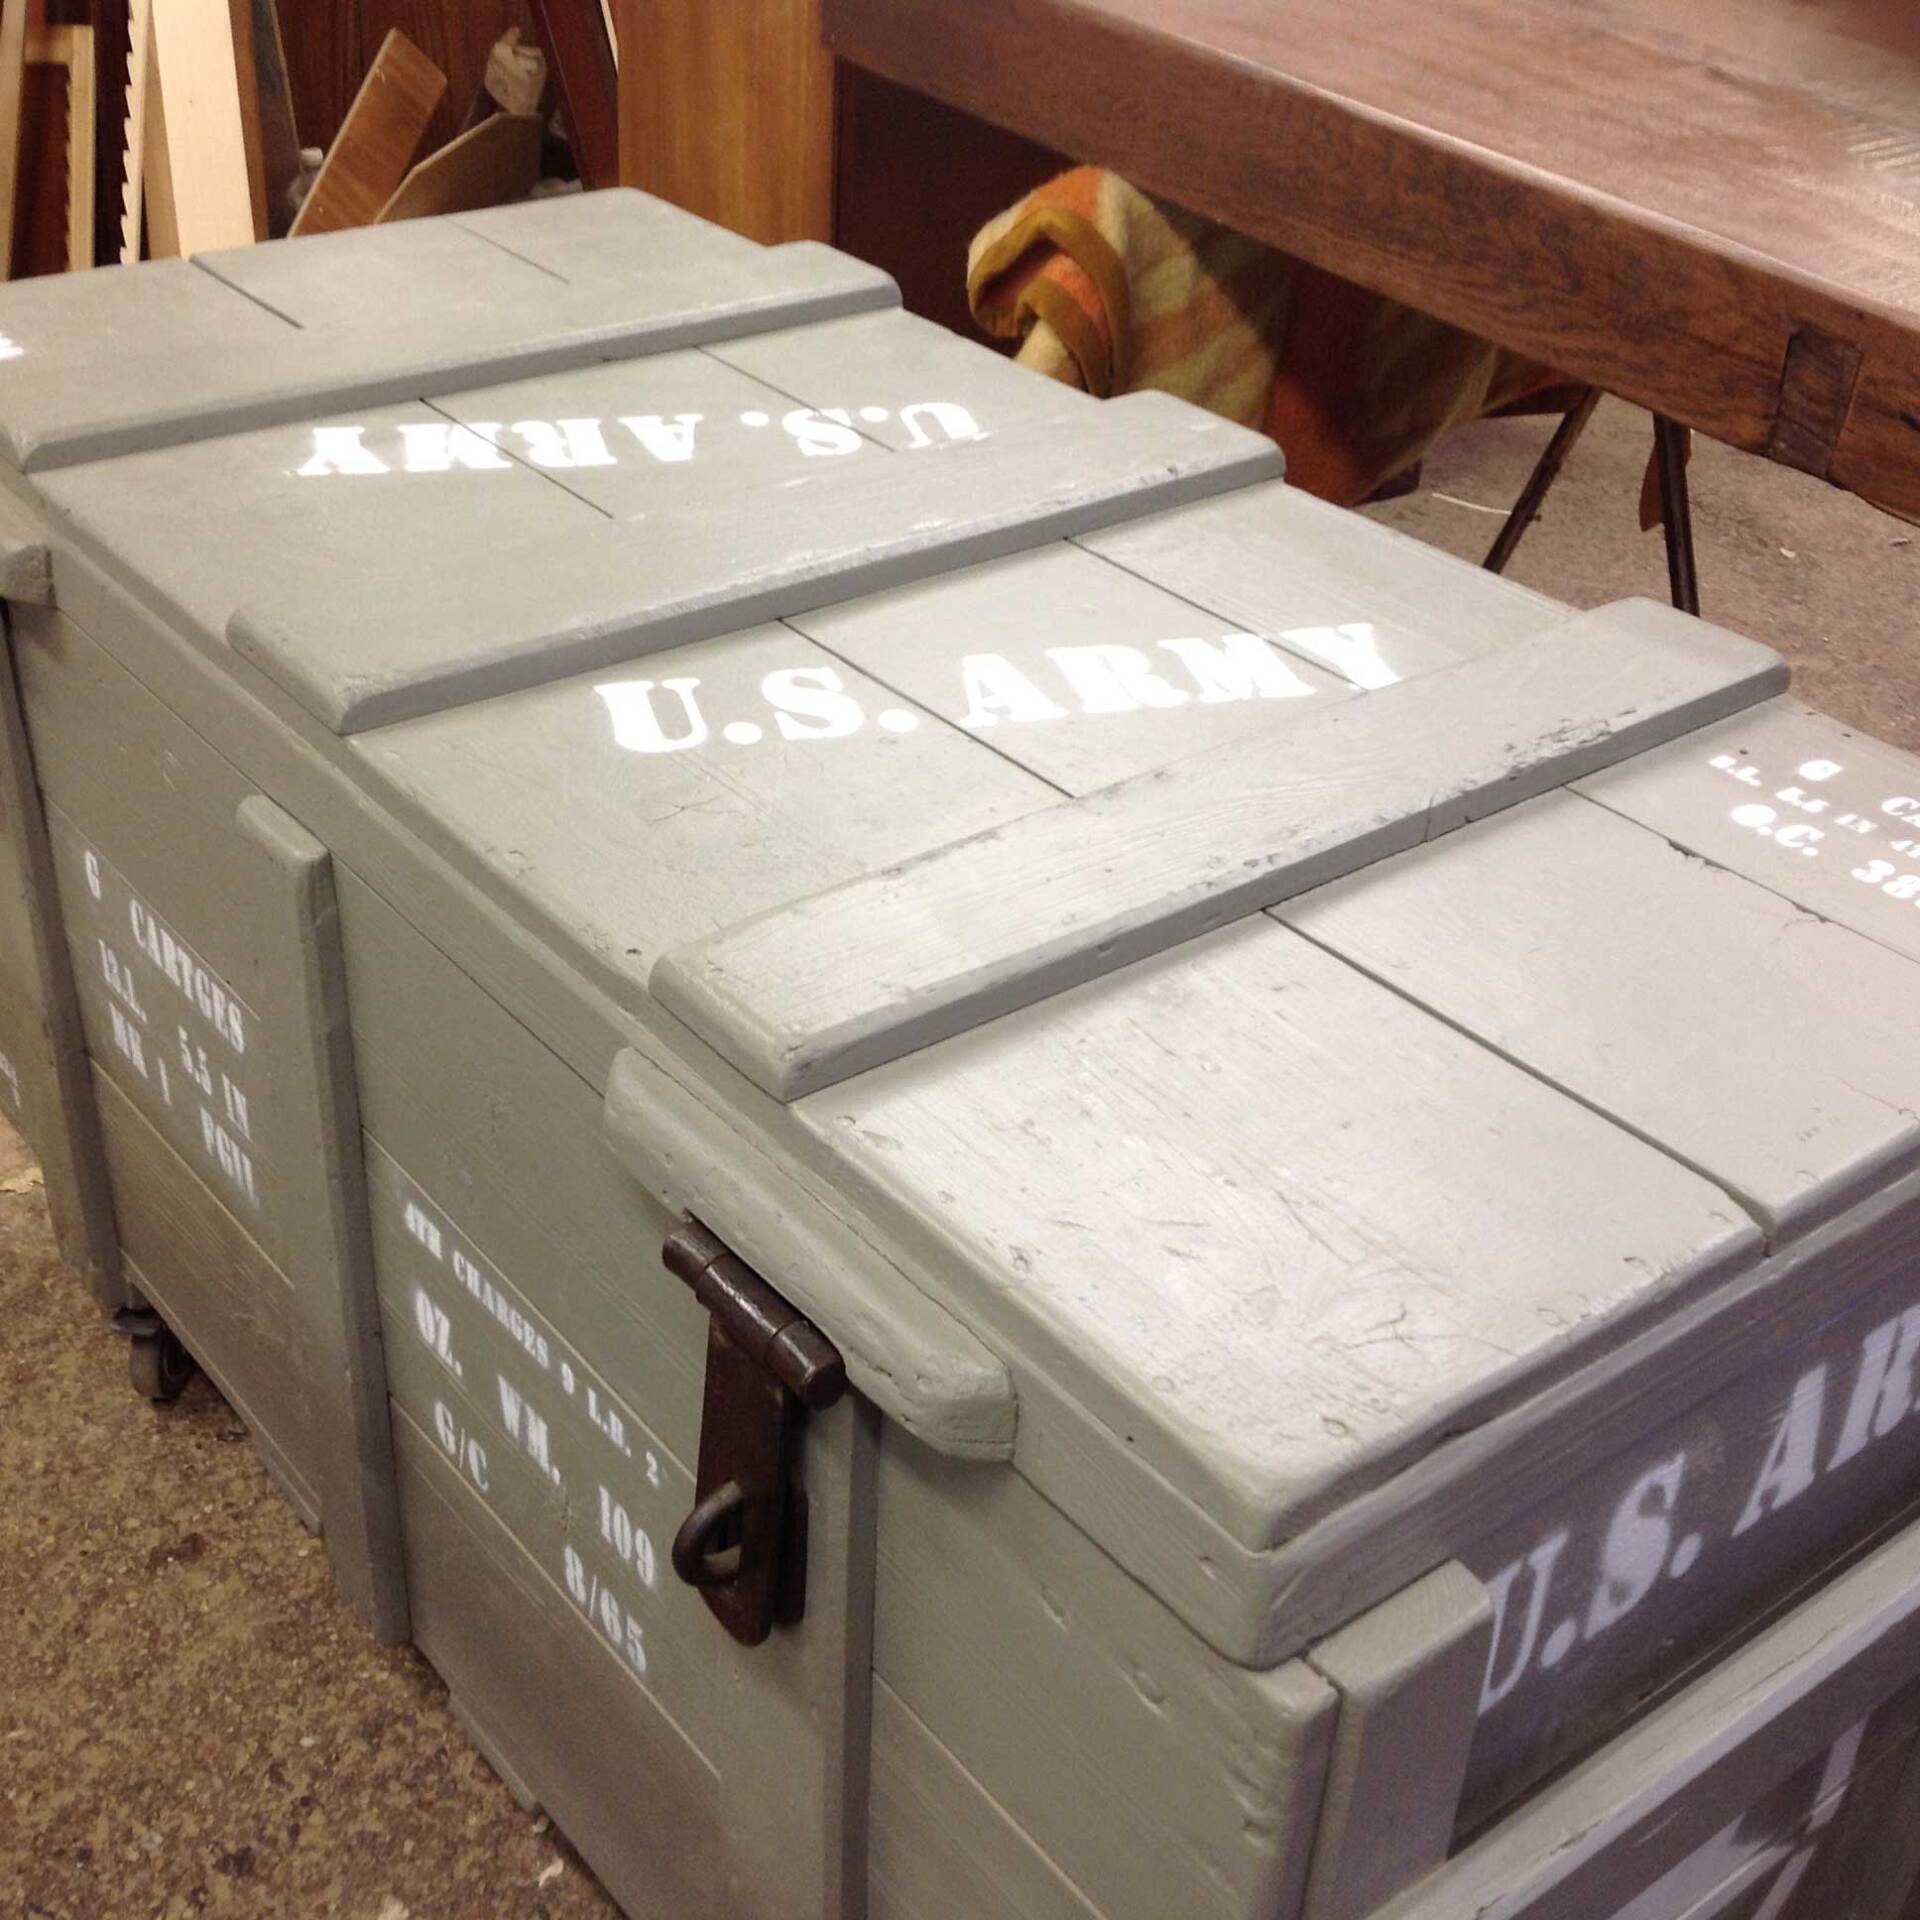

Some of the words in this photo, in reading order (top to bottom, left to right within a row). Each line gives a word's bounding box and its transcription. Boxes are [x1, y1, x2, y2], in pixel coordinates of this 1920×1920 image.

[297, 412, 704, 476] ARMY
[739, 402, 990, 458] U.S.
[593, 667, 920, 754] U.S.
[958, 622, 1404, 729] ARMY
[130, 898, 246, 1054] CARTGES
[453, 1250, 549, 1369] CHARGES
[599, 1484, 656, 1590] 109
[1478, 1451, 1702, 1717] U.S.
[563, 1544, 647, 1674] 8/65
